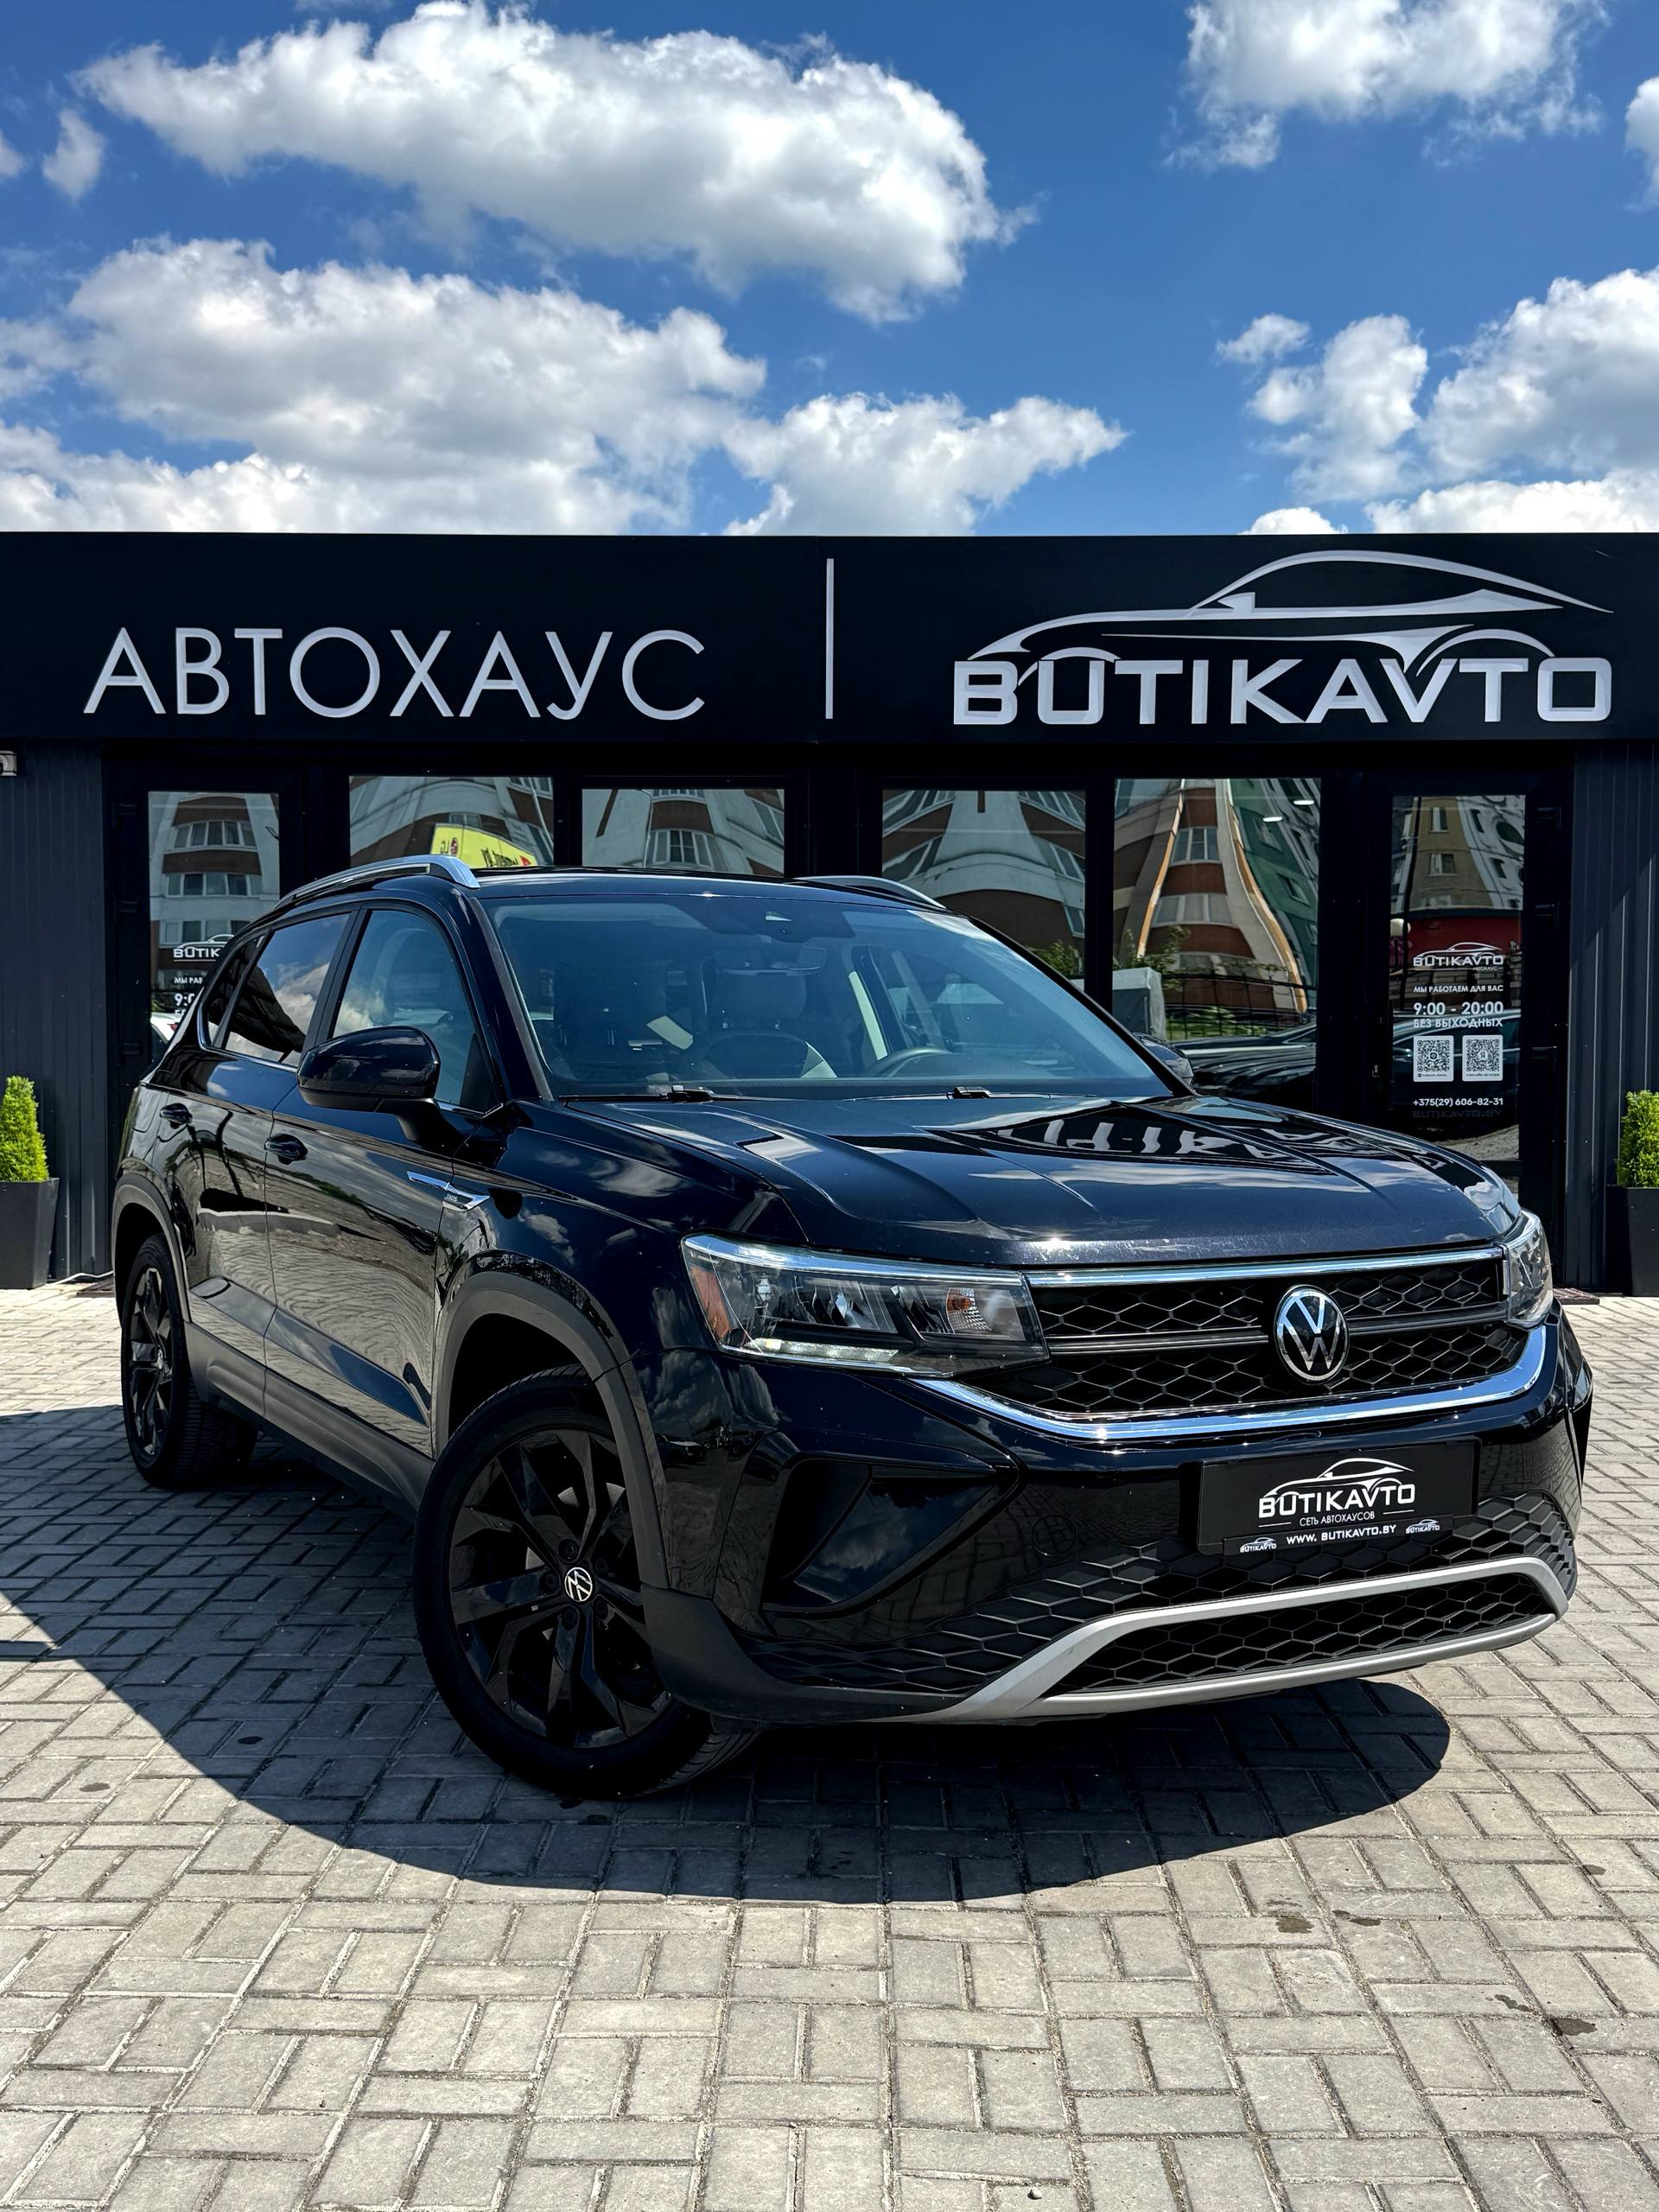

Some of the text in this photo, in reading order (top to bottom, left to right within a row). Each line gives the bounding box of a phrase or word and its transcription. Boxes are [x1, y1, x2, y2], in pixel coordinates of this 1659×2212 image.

[83, 626, 705, 721] АВТОХАУС
[953, 655, 1612, 726] BUTIKAVTO
[174, 948, 220, 958] BUTIK
[1413, 955, 1503, 967] BUTIKAVTO
[1413, 1002, 1446, 1015] 9:00
[1461, 1001, 1503, 1015] 20:00
[1413, 1018, 1503, 1028] БЕЗ ВЫХОДНЫХ
[1413, 1097, 1503, 1108] +375(29) 606-82-31
[1258, 1483, 1415, 1519] BUTIKAVTO
[1299, 1511, 1376, 1527] СЕТЬ АВТОХАУСОВ
[1286, 1524, 1397, 1545] WWW. BUTIKAVTO.BY
[1406, 1525, 1440, 1535] BUTIKAVTO
[1240, 1543, 1277, 1553] BUTIKAVTO
